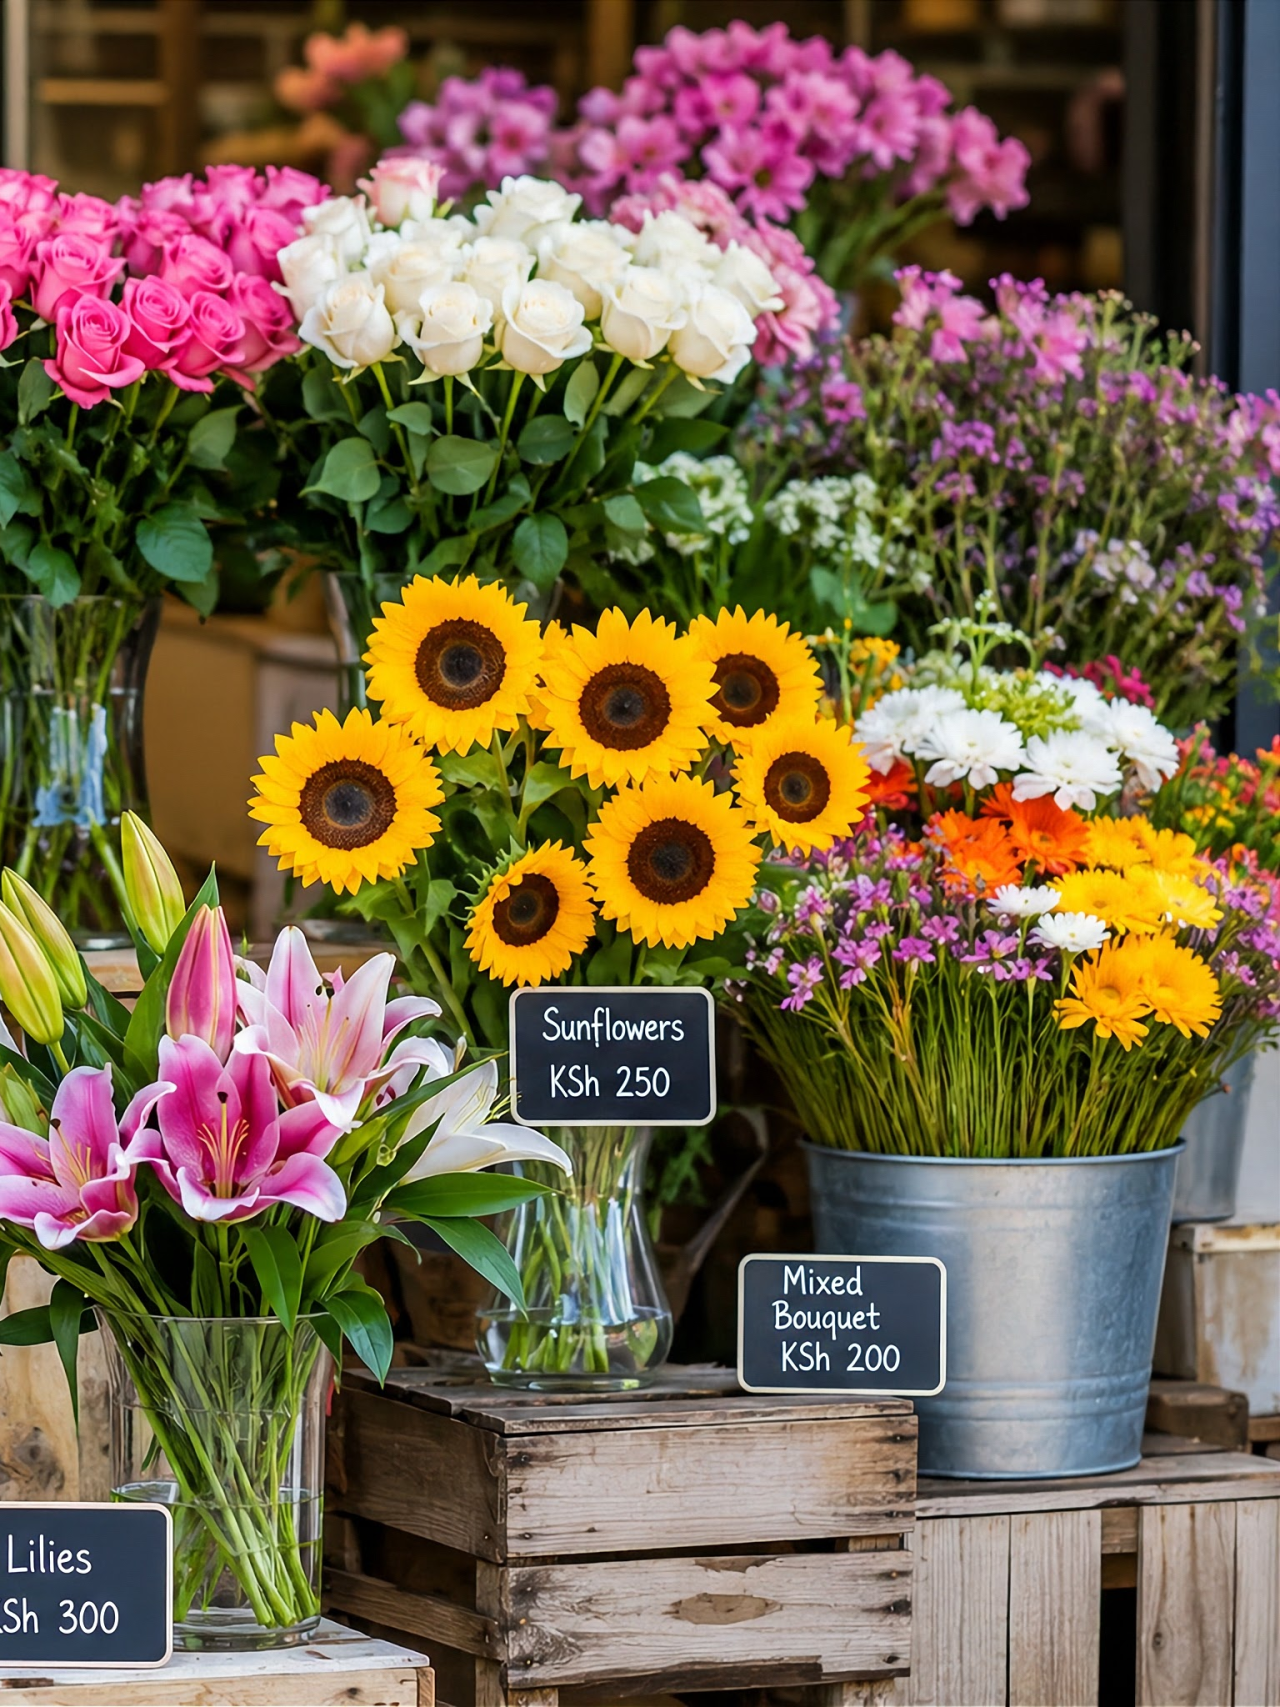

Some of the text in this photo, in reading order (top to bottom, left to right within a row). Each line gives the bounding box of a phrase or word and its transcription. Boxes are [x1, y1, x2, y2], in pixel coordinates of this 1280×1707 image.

[542, 1006, 685, 1048] Sunflowers
[550, 1064, 671, 1098] KSh 250
[783, 1264, 864, 1297] Mixed
[771, 1299, 881, 1341] Bouquet
[781, 1340, 901, 1372] KSh 200
[7, 1533, 92, 1575] Lilies
[58, 1599, 119, 1635] 300
